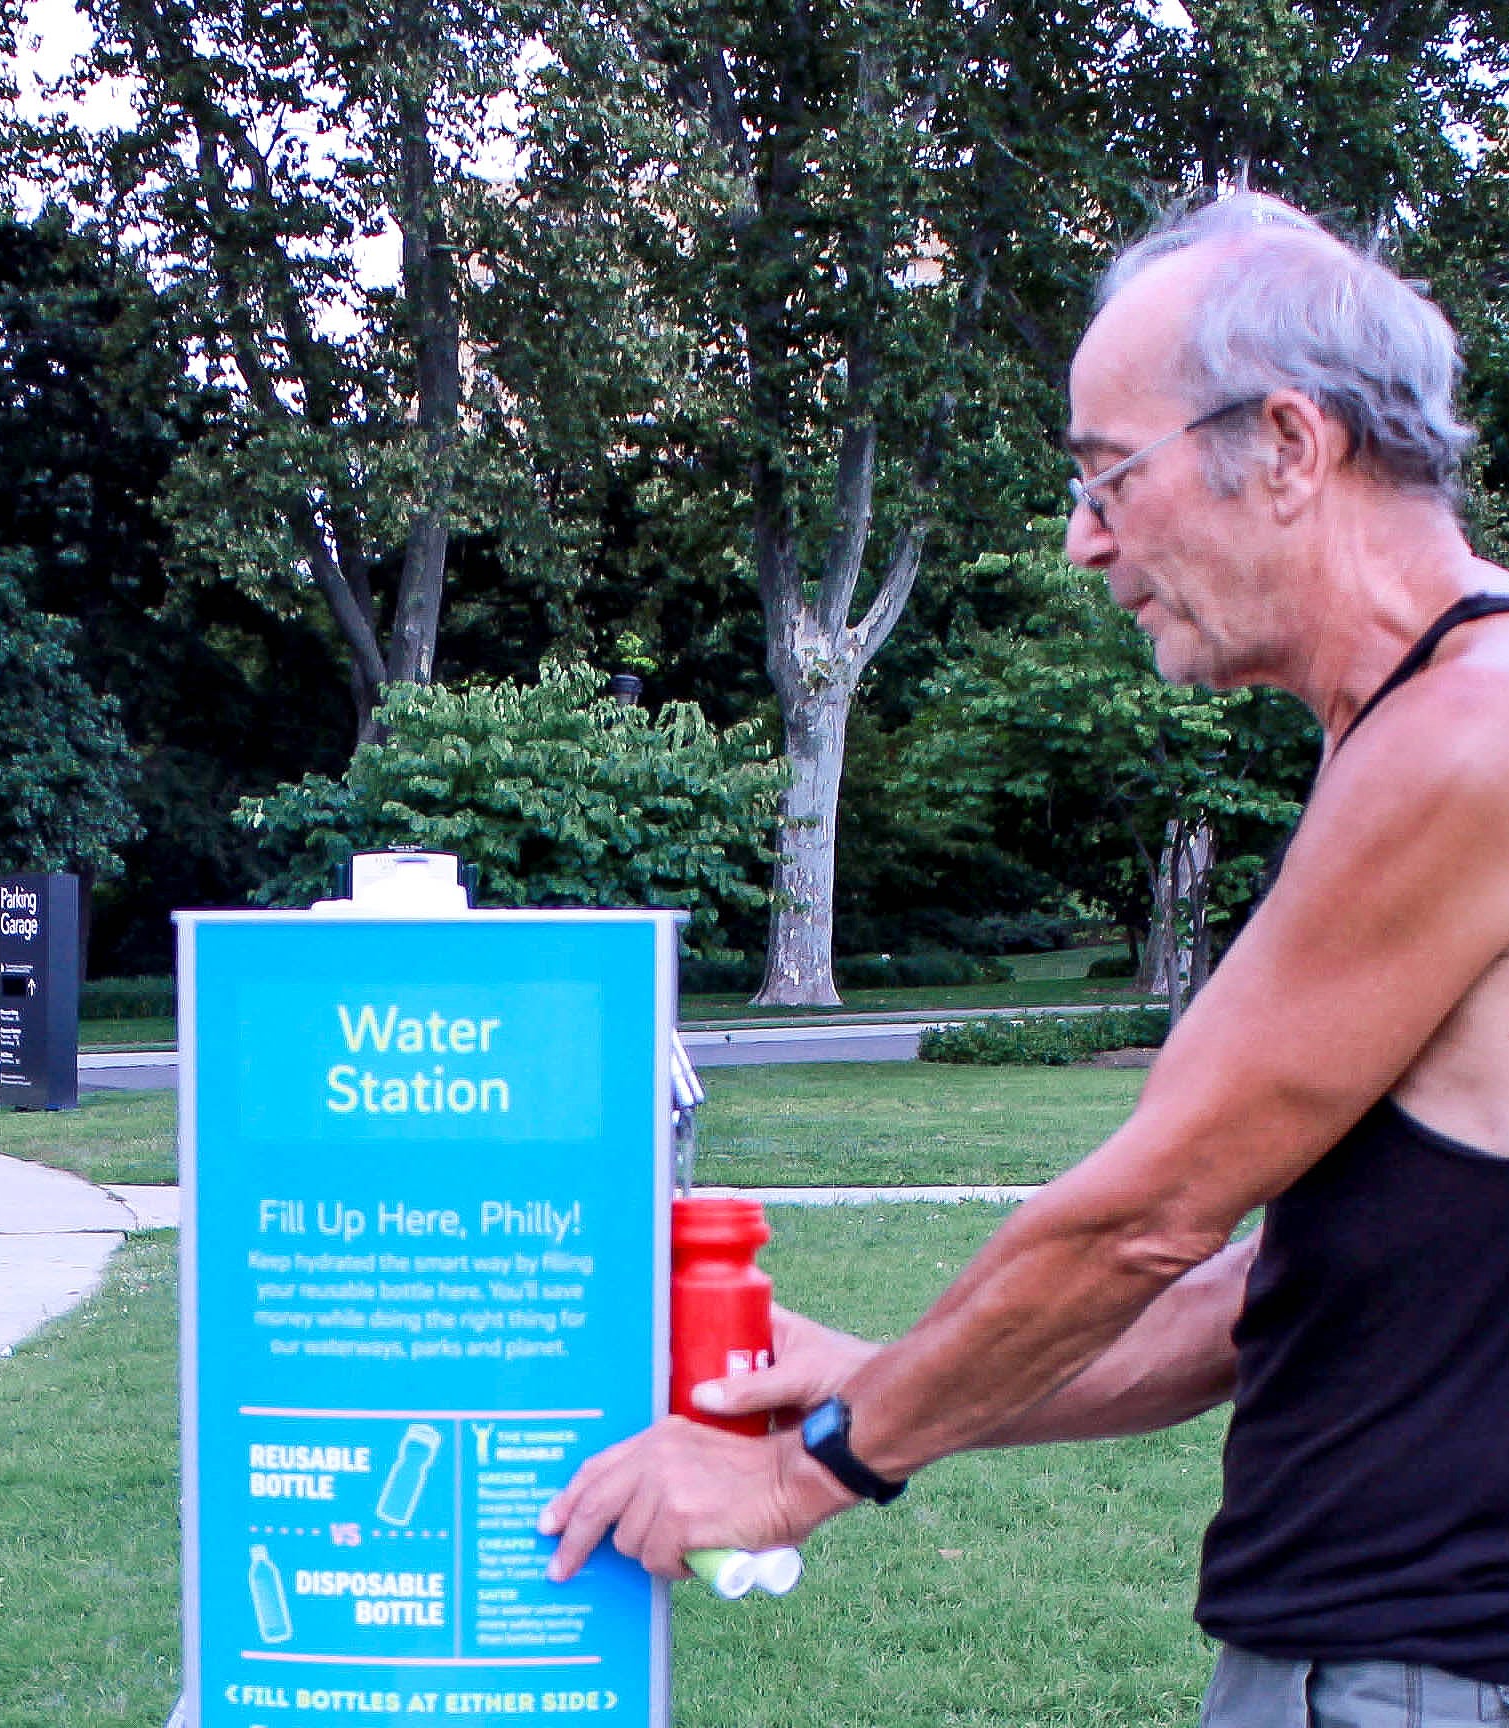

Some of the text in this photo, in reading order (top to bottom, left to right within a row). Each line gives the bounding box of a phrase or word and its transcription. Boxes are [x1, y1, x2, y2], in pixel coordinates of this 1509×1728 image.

[0, 886, 37, 915] Parking
[0, 912, 38, 941] Garage
[338, 1004, 501, 1054] Water
[327, 1064, 509, 1113] Station
[258, 1199, 582, 1243] Fill Up Here, Philly!
[295, 1252, 375, 1273] hydrated
[379, 1252, 410, 1271] the
[414, 1254, 469, 1271] smart
[473, 1255, 510, 1275] way
[515, 1252, 538, 1274] by
[379, 1281, 434, 1299] bottle
[542, 1284, 584, 1300] save
[559, 1308, 587, 1327] for
[466, 1339, 502, 1357] and
[249, 1444, 370, 1473] REUSABLE
[249, 1472, 335, 1500] BOTTLE
[330, 1523, 362, 1547] VS
[295, 1570, 445, 1598] DISPOSABLE
[355, 1600, 445, 1627] BOTTLE
[243, 1684, 599, 1714] FILL BOTTLES AT EITHER SIDE
